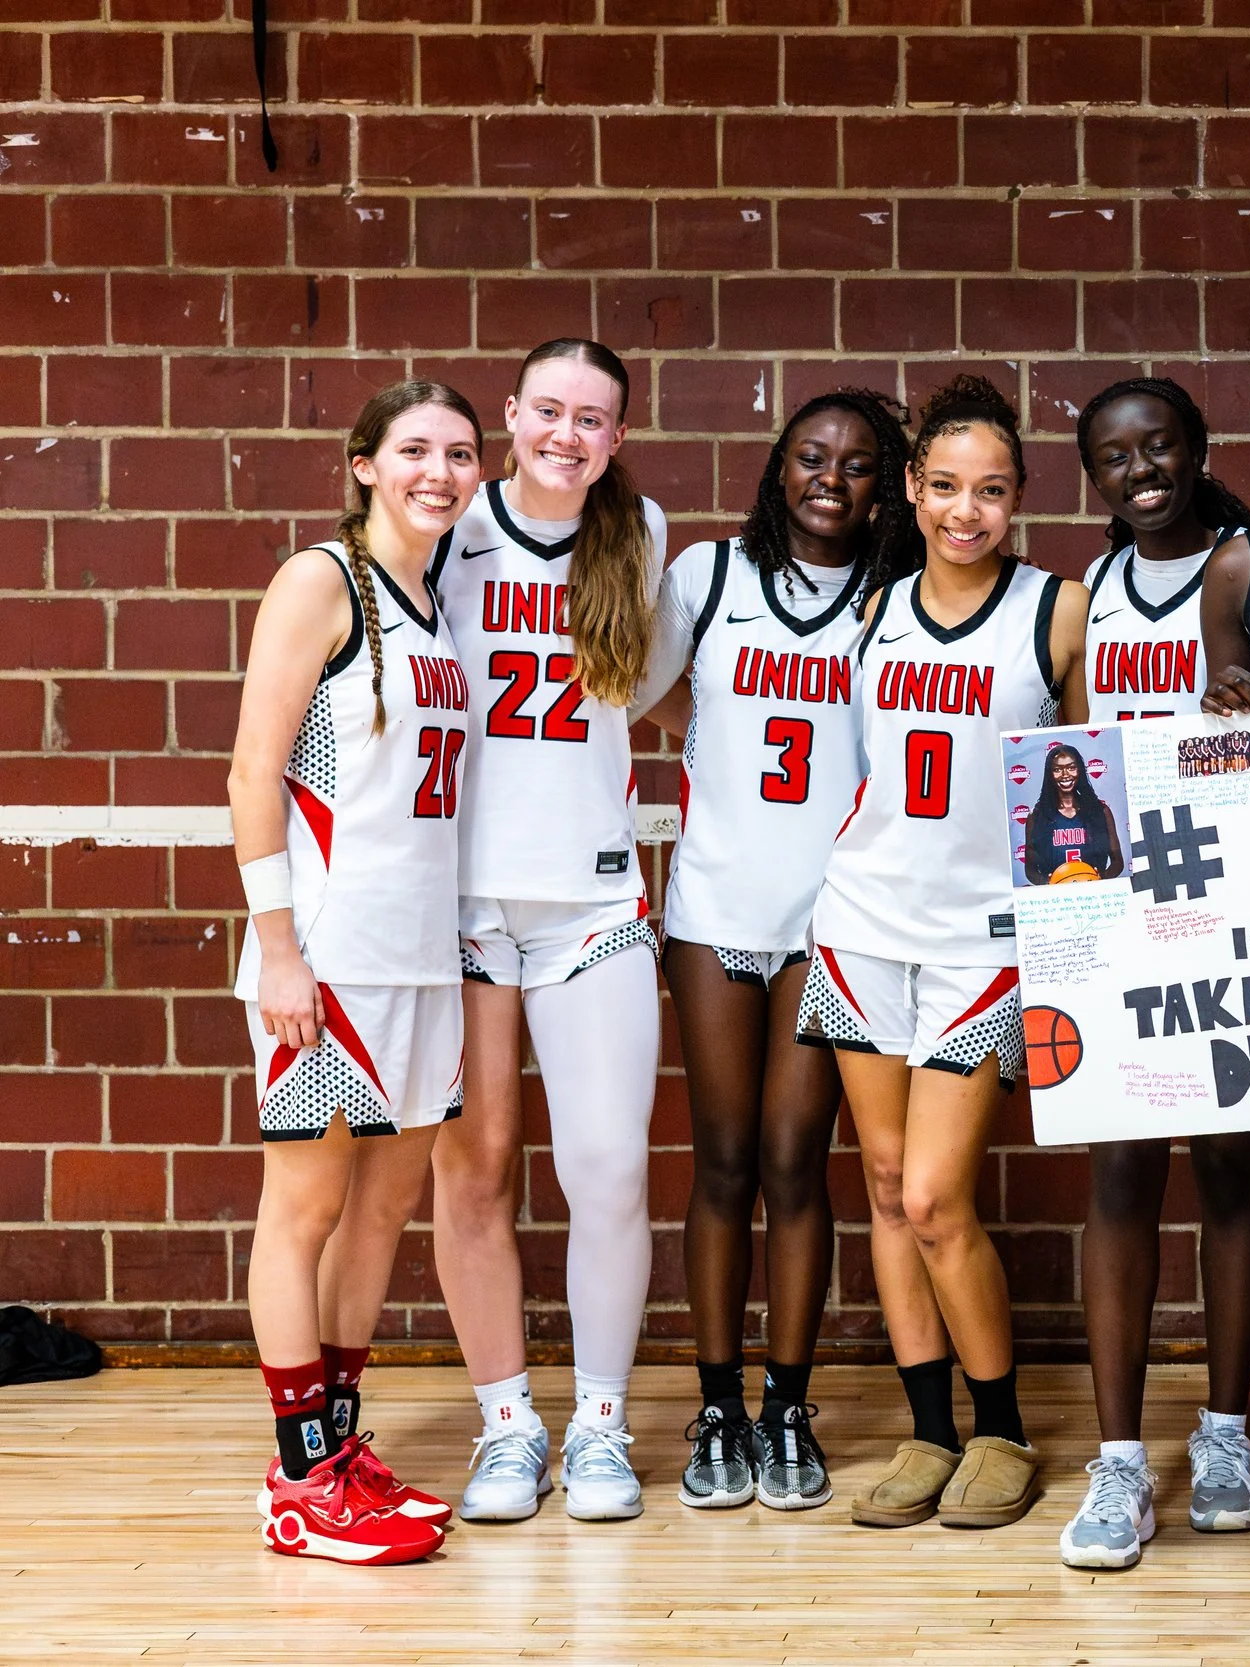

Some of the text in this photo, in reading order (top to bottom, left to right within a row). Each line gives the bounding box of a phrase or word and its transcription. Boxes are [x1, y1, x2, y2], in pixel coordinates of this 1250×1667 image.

[486, 650, 589, 743] 22
[733, 646, 851, 705] UNION
[877, 661, 994, 718] UNION
[1095, 640, 1198, 694] UNION
[413, 726, 466, 819] 20
[760, 716, 814, 805] 3
[905, 729, 953, 820] 0
[1156, 914, 1170, 923] only
[1170, 911, 1193, 919] known
[1152, 1072, 1173, 1082] playing
